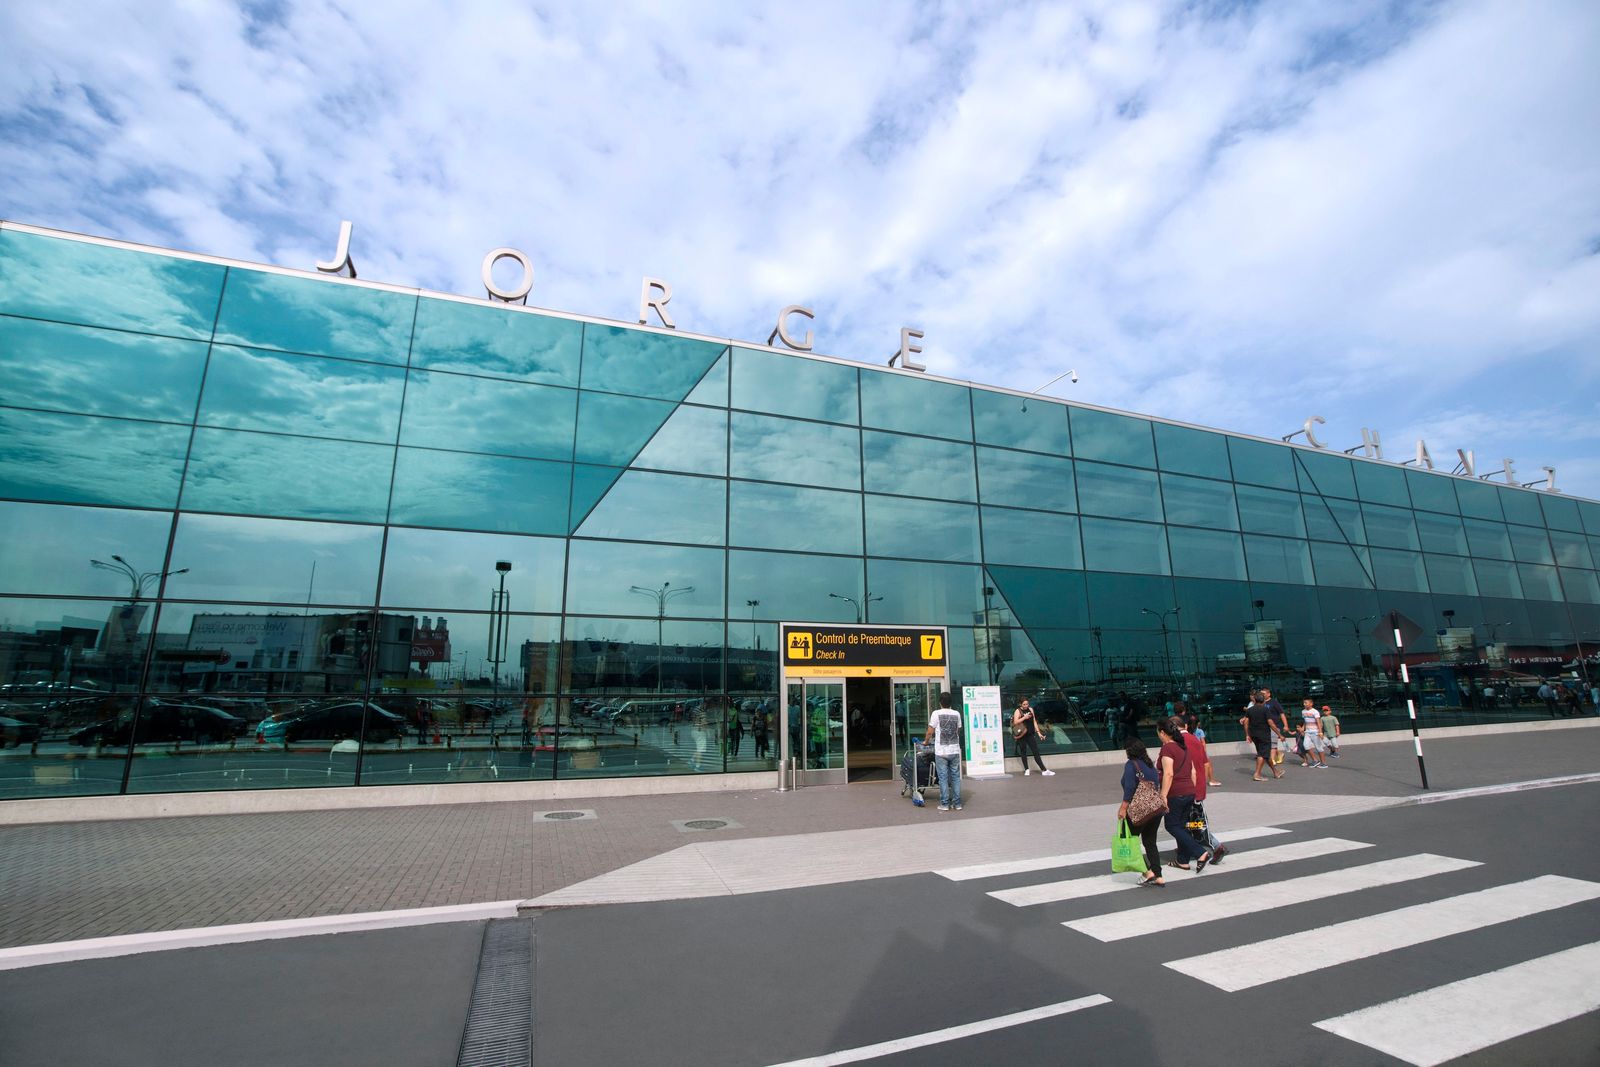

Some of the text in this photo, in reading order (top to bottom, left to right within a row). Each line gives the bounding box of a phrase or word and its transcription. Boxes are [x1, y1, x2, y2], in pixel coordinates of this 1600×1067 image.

[316, 219, 1562, 493] JORGE CHAVEZ
[815, 632, 912, 647] Control de Preembarque
[926, 637, 936, 657] 7
[815, 649, 846, 660] Check In
